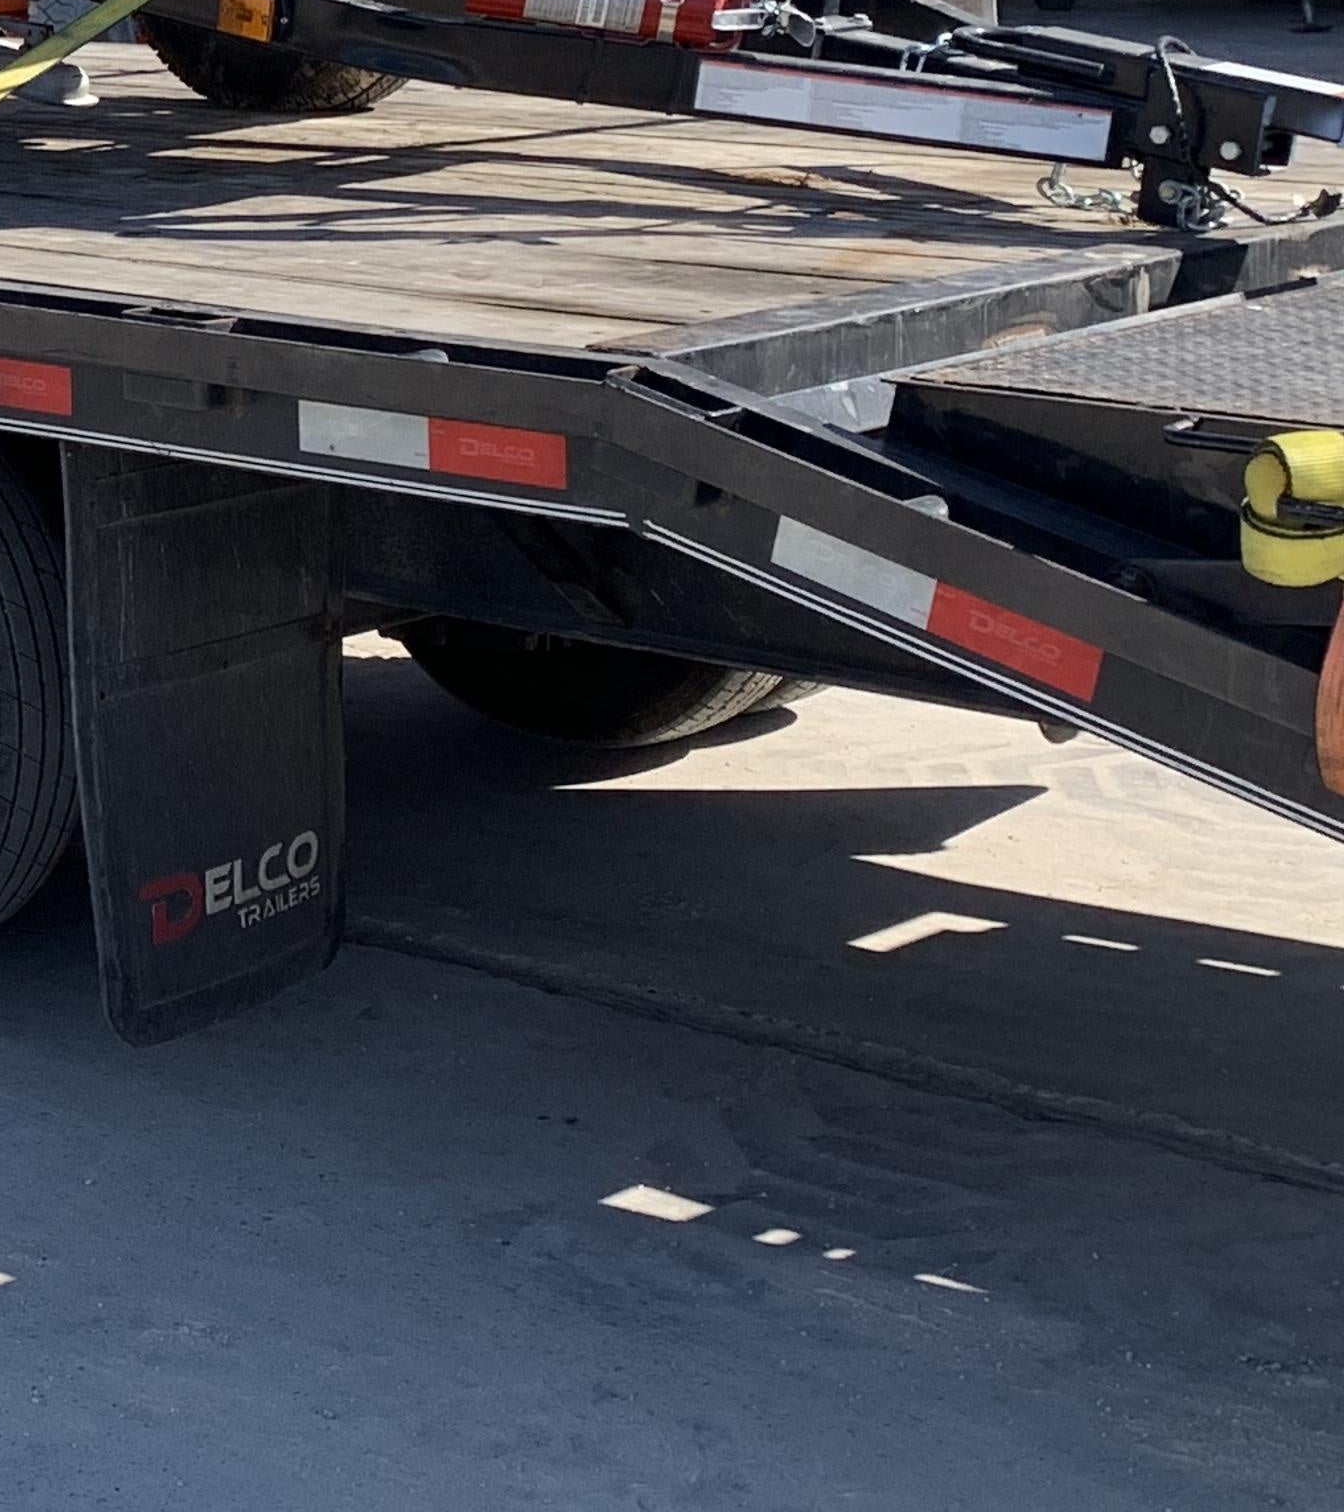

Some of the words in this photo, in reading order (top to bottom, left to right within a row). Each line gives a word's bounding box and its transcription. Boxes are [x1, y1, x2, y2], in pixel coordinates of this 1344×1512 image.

[458, 436, 536, 461] DELCO
[968, 609, 1062, 661] DELCO
[139, 829, 319, 946] DELCO
[236, 874, 321, 929] TRAILERS
